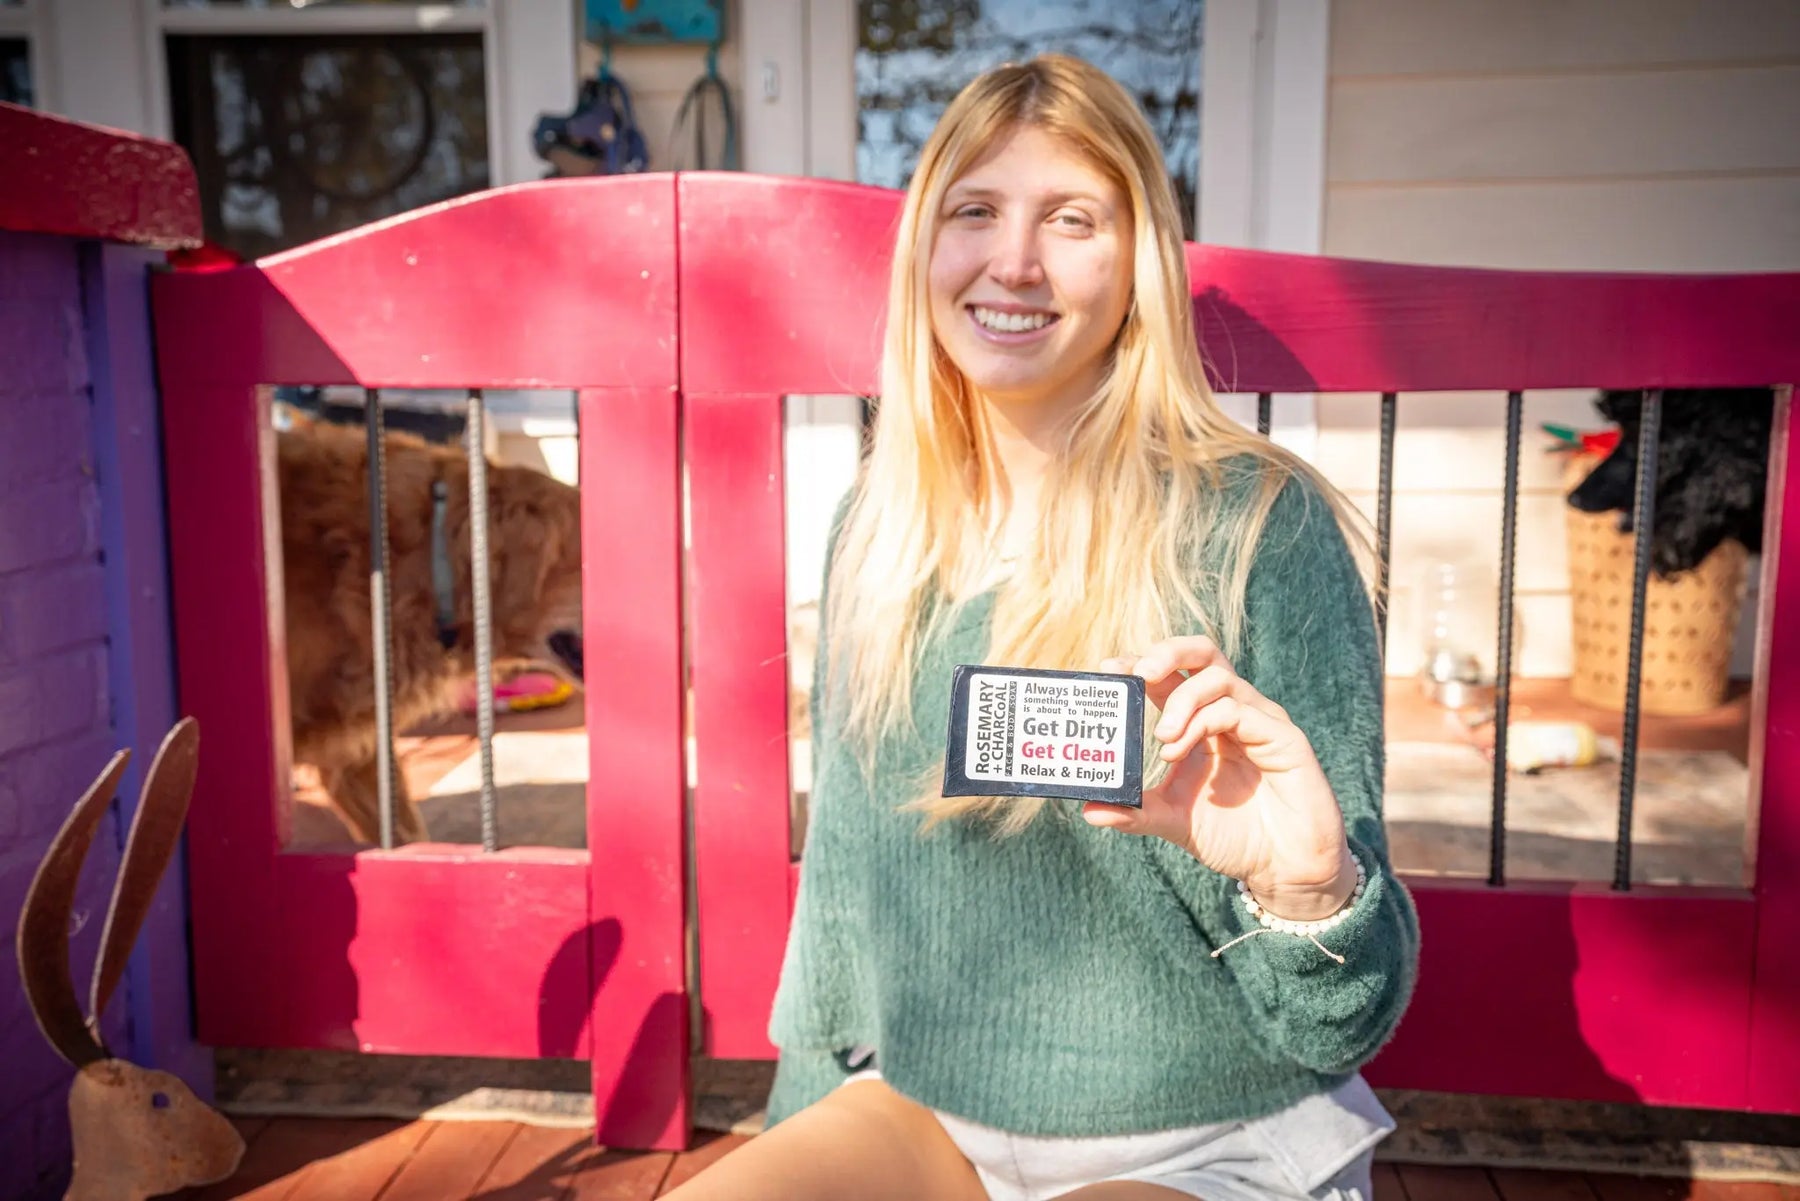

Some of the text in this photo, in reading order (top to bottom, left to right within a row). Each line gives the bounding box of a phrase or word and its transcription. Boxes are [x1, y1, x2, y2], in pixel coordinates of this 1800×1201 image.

[1024, 683, 1119, 699] Always believe
[1023, 696, 1119, 709] something wonderful
[1036, 705, 1061, 714] about
[1083, 708, 1118, 719] happen.
[975, 680, 994, 773] RoSEMARY
[1005, 752, 1013, 776] FACE
[1009, 681, 1017, 709] SOAP
[1023, 717, 1117, 745] Get Dirty
[1021, 741, 1115, 763] Get Clean
[1020, 763, 1115, 783] Relax & Enjoy!
